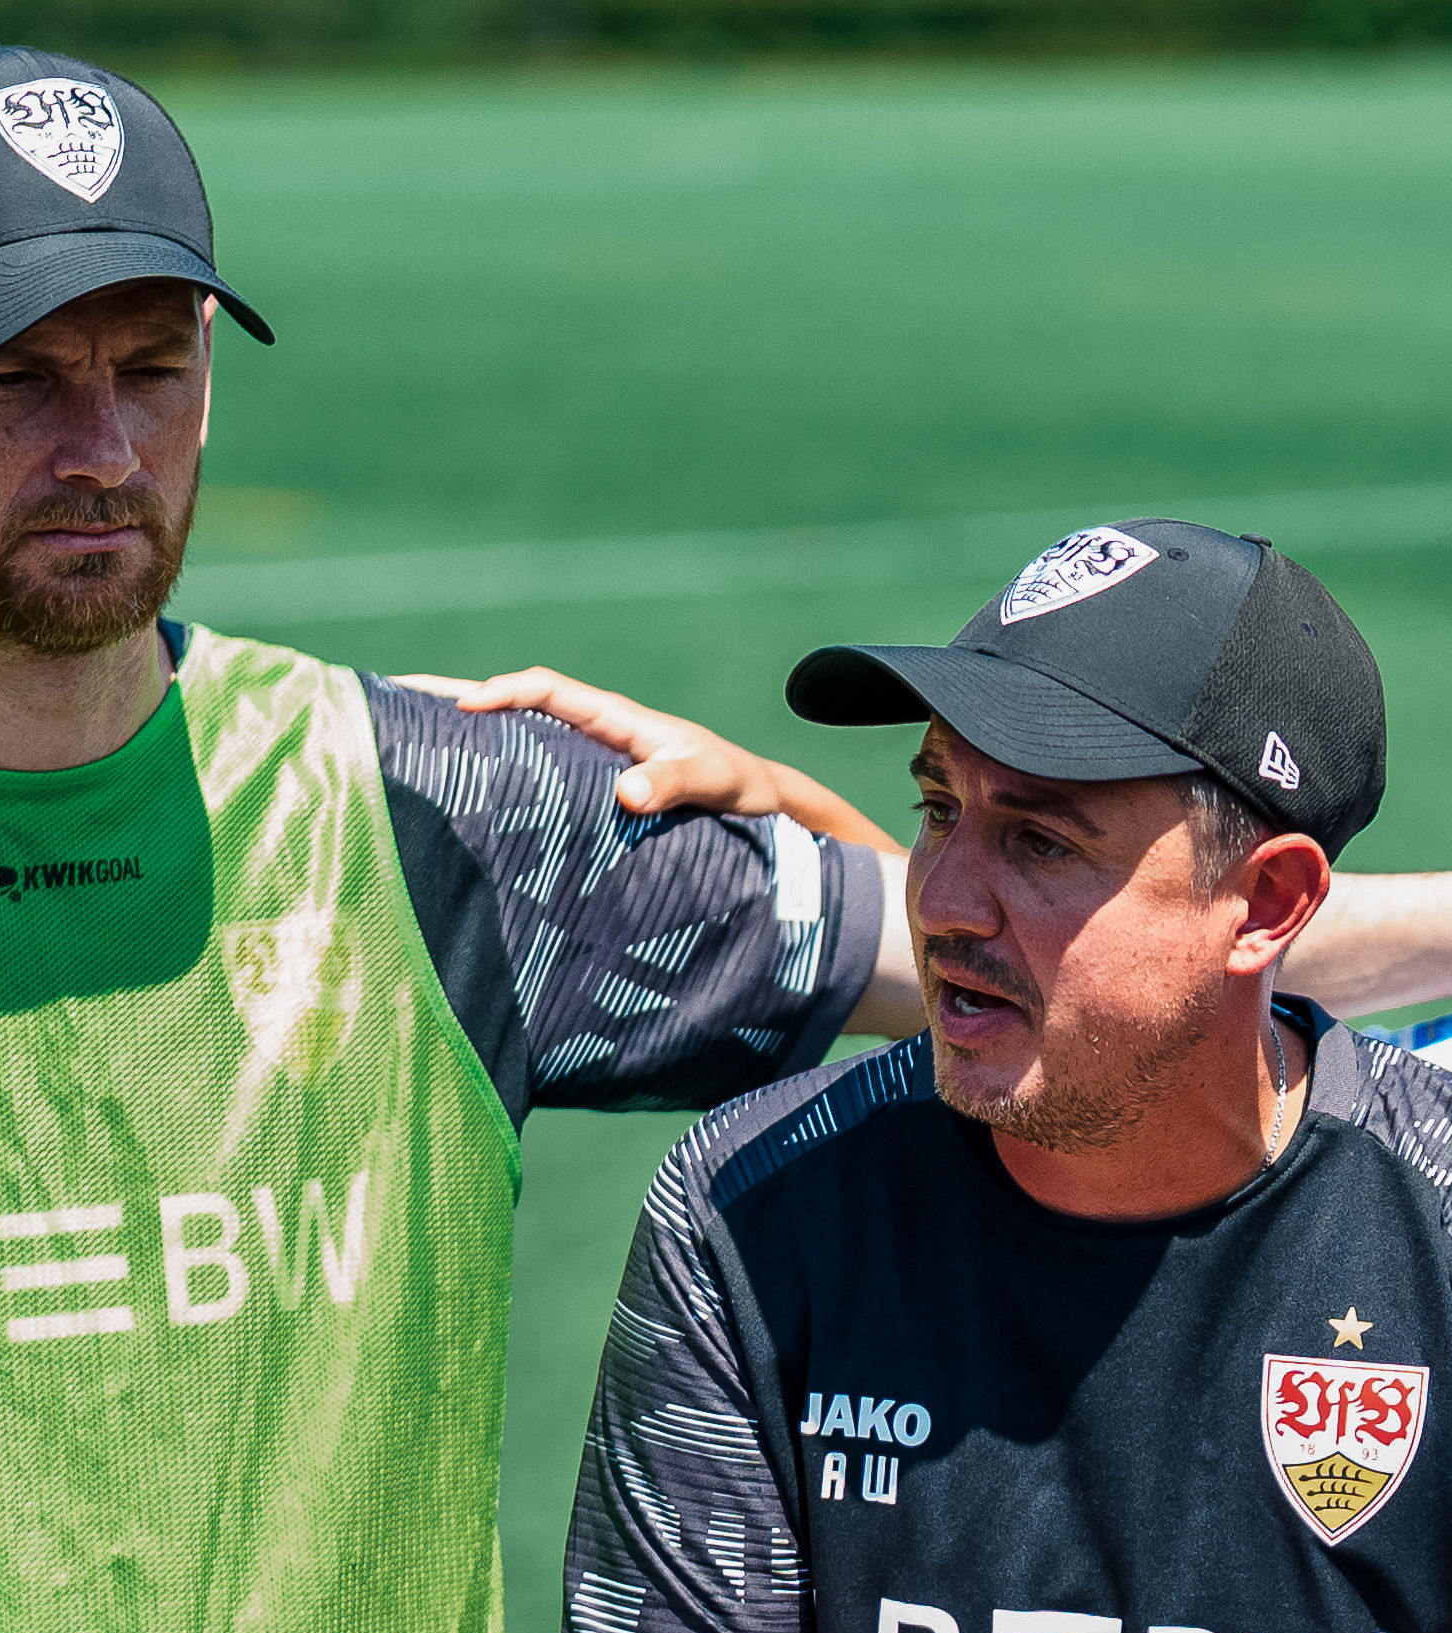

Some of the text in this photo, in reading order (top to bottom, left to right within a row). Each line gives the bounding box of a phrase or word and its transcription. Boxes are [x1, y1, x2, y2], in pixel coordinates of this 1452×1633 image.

[800, 1392, 932, 1447] JAKO
[1275, 1370, 1415, 1447] VfB
[820, 1452, 899, 1505] A W
